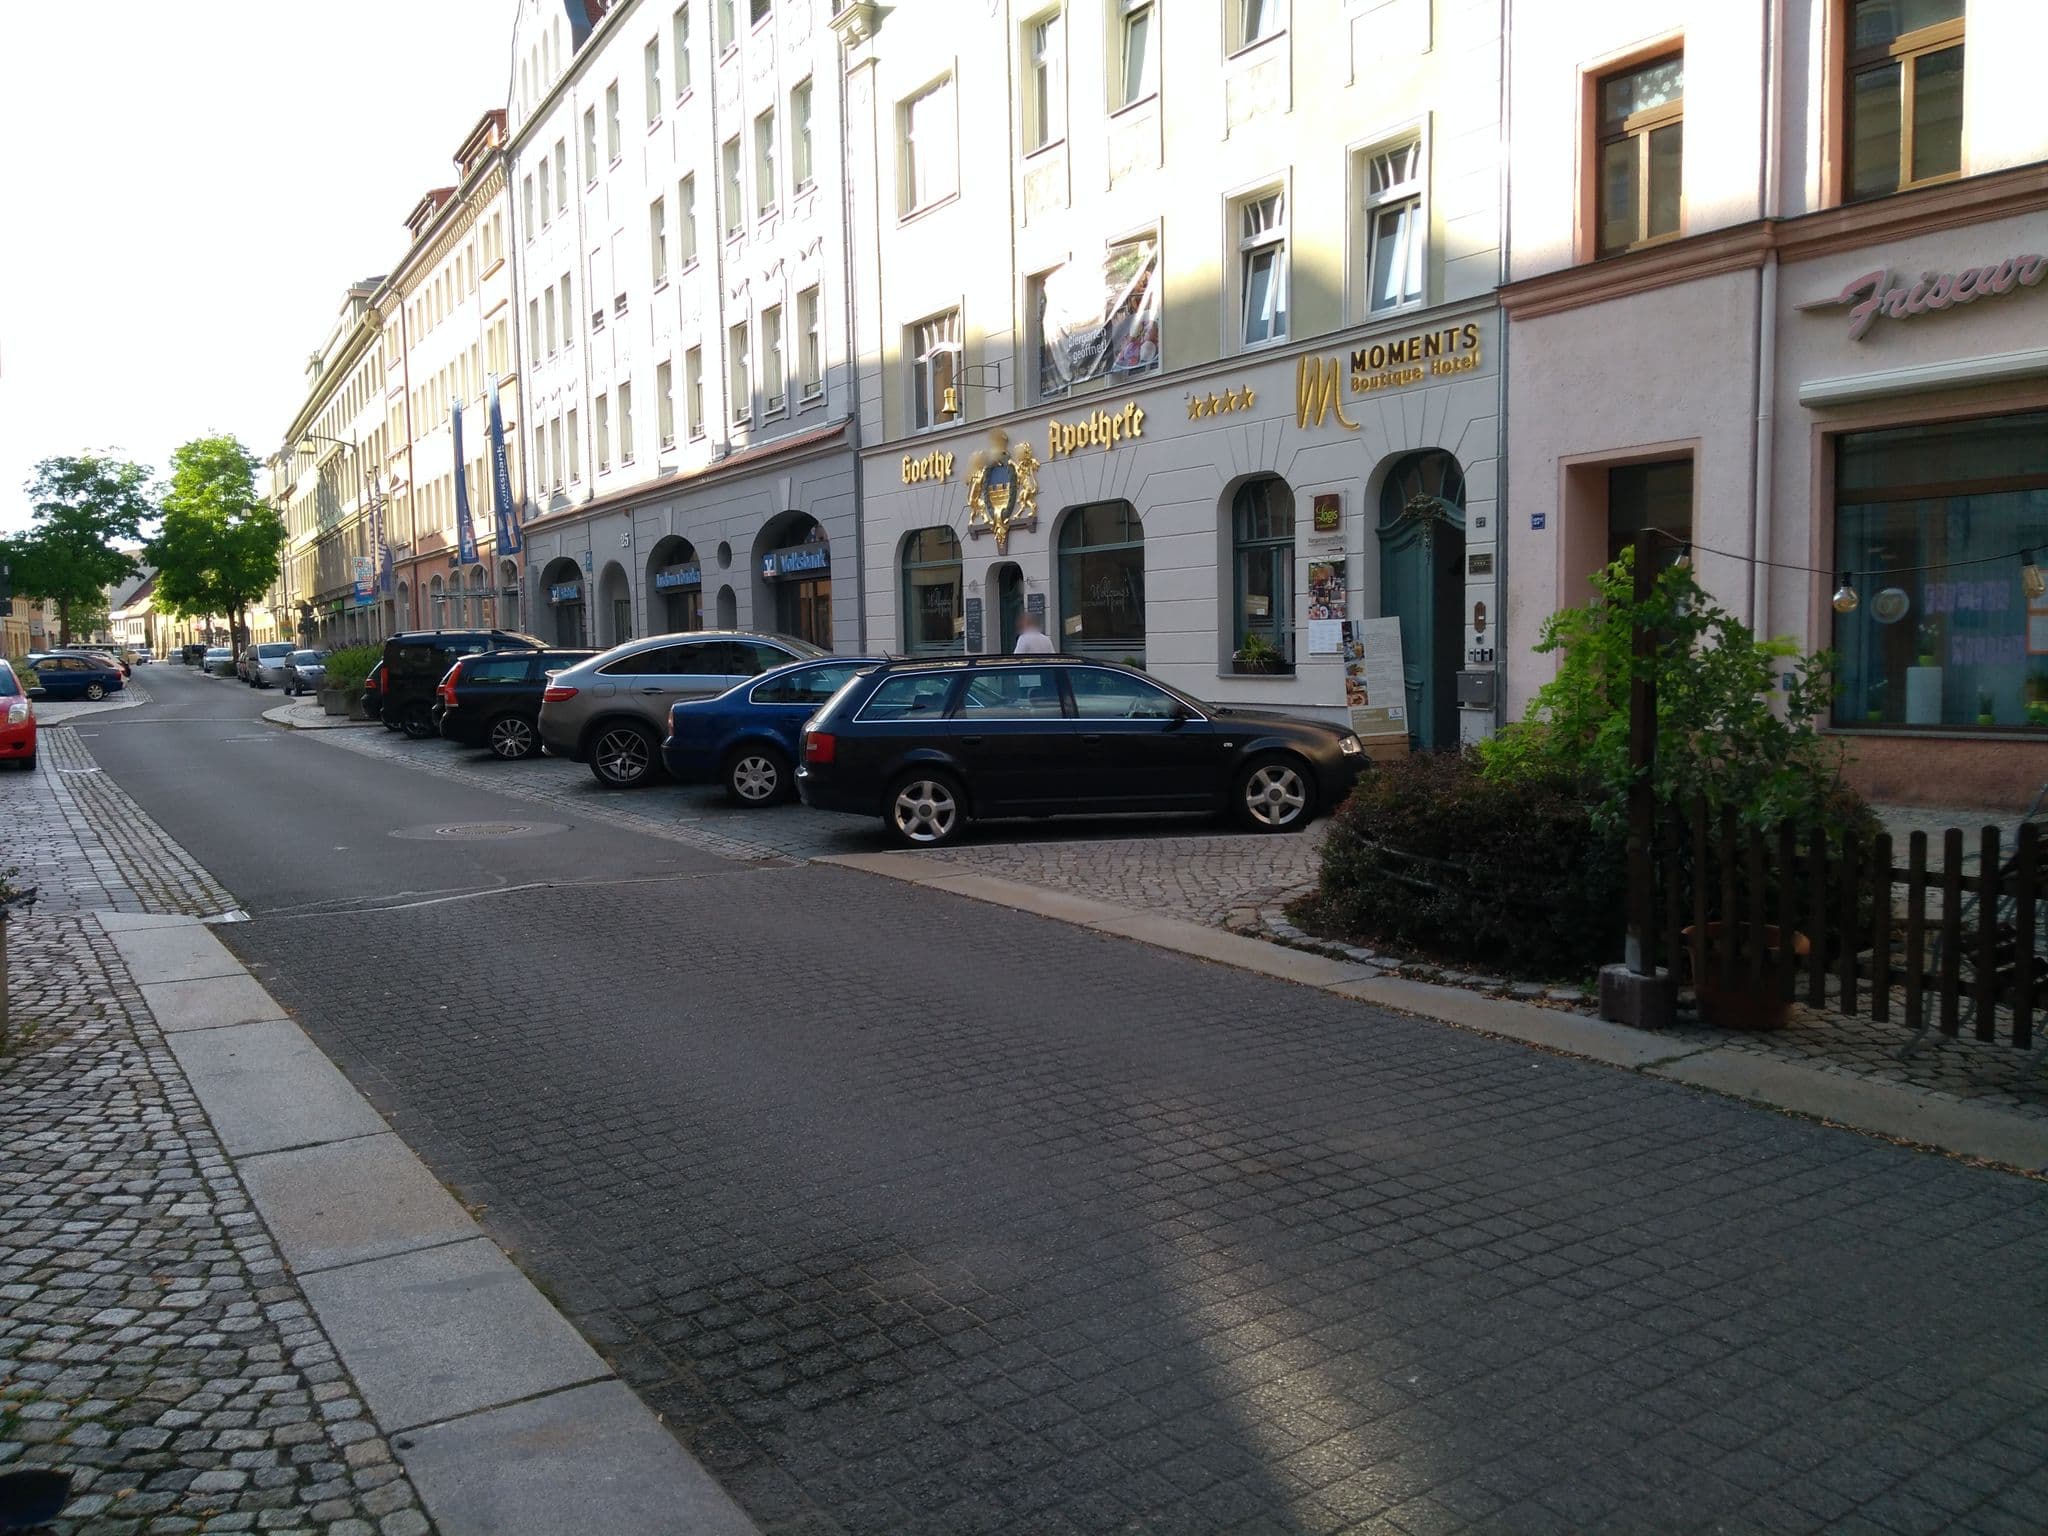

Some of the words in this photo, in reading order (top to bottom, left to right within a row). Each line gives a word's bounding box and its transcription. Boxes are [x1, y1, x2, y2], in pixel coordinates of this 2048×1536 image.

[1793, 254, 2048, 340] Friseur
[1351, 323, 1479, 374] MOMENTS
[1351, 366, 1424, 392] Boutique
[1431, 351, 1480, 376] Hotel
[901, 449, 955, 484] Goethe
[1048, 401, 1146, 461] Apotheke
[620, 533, 630, 548] 25
[781, 547, 827, 573] Volksbank
